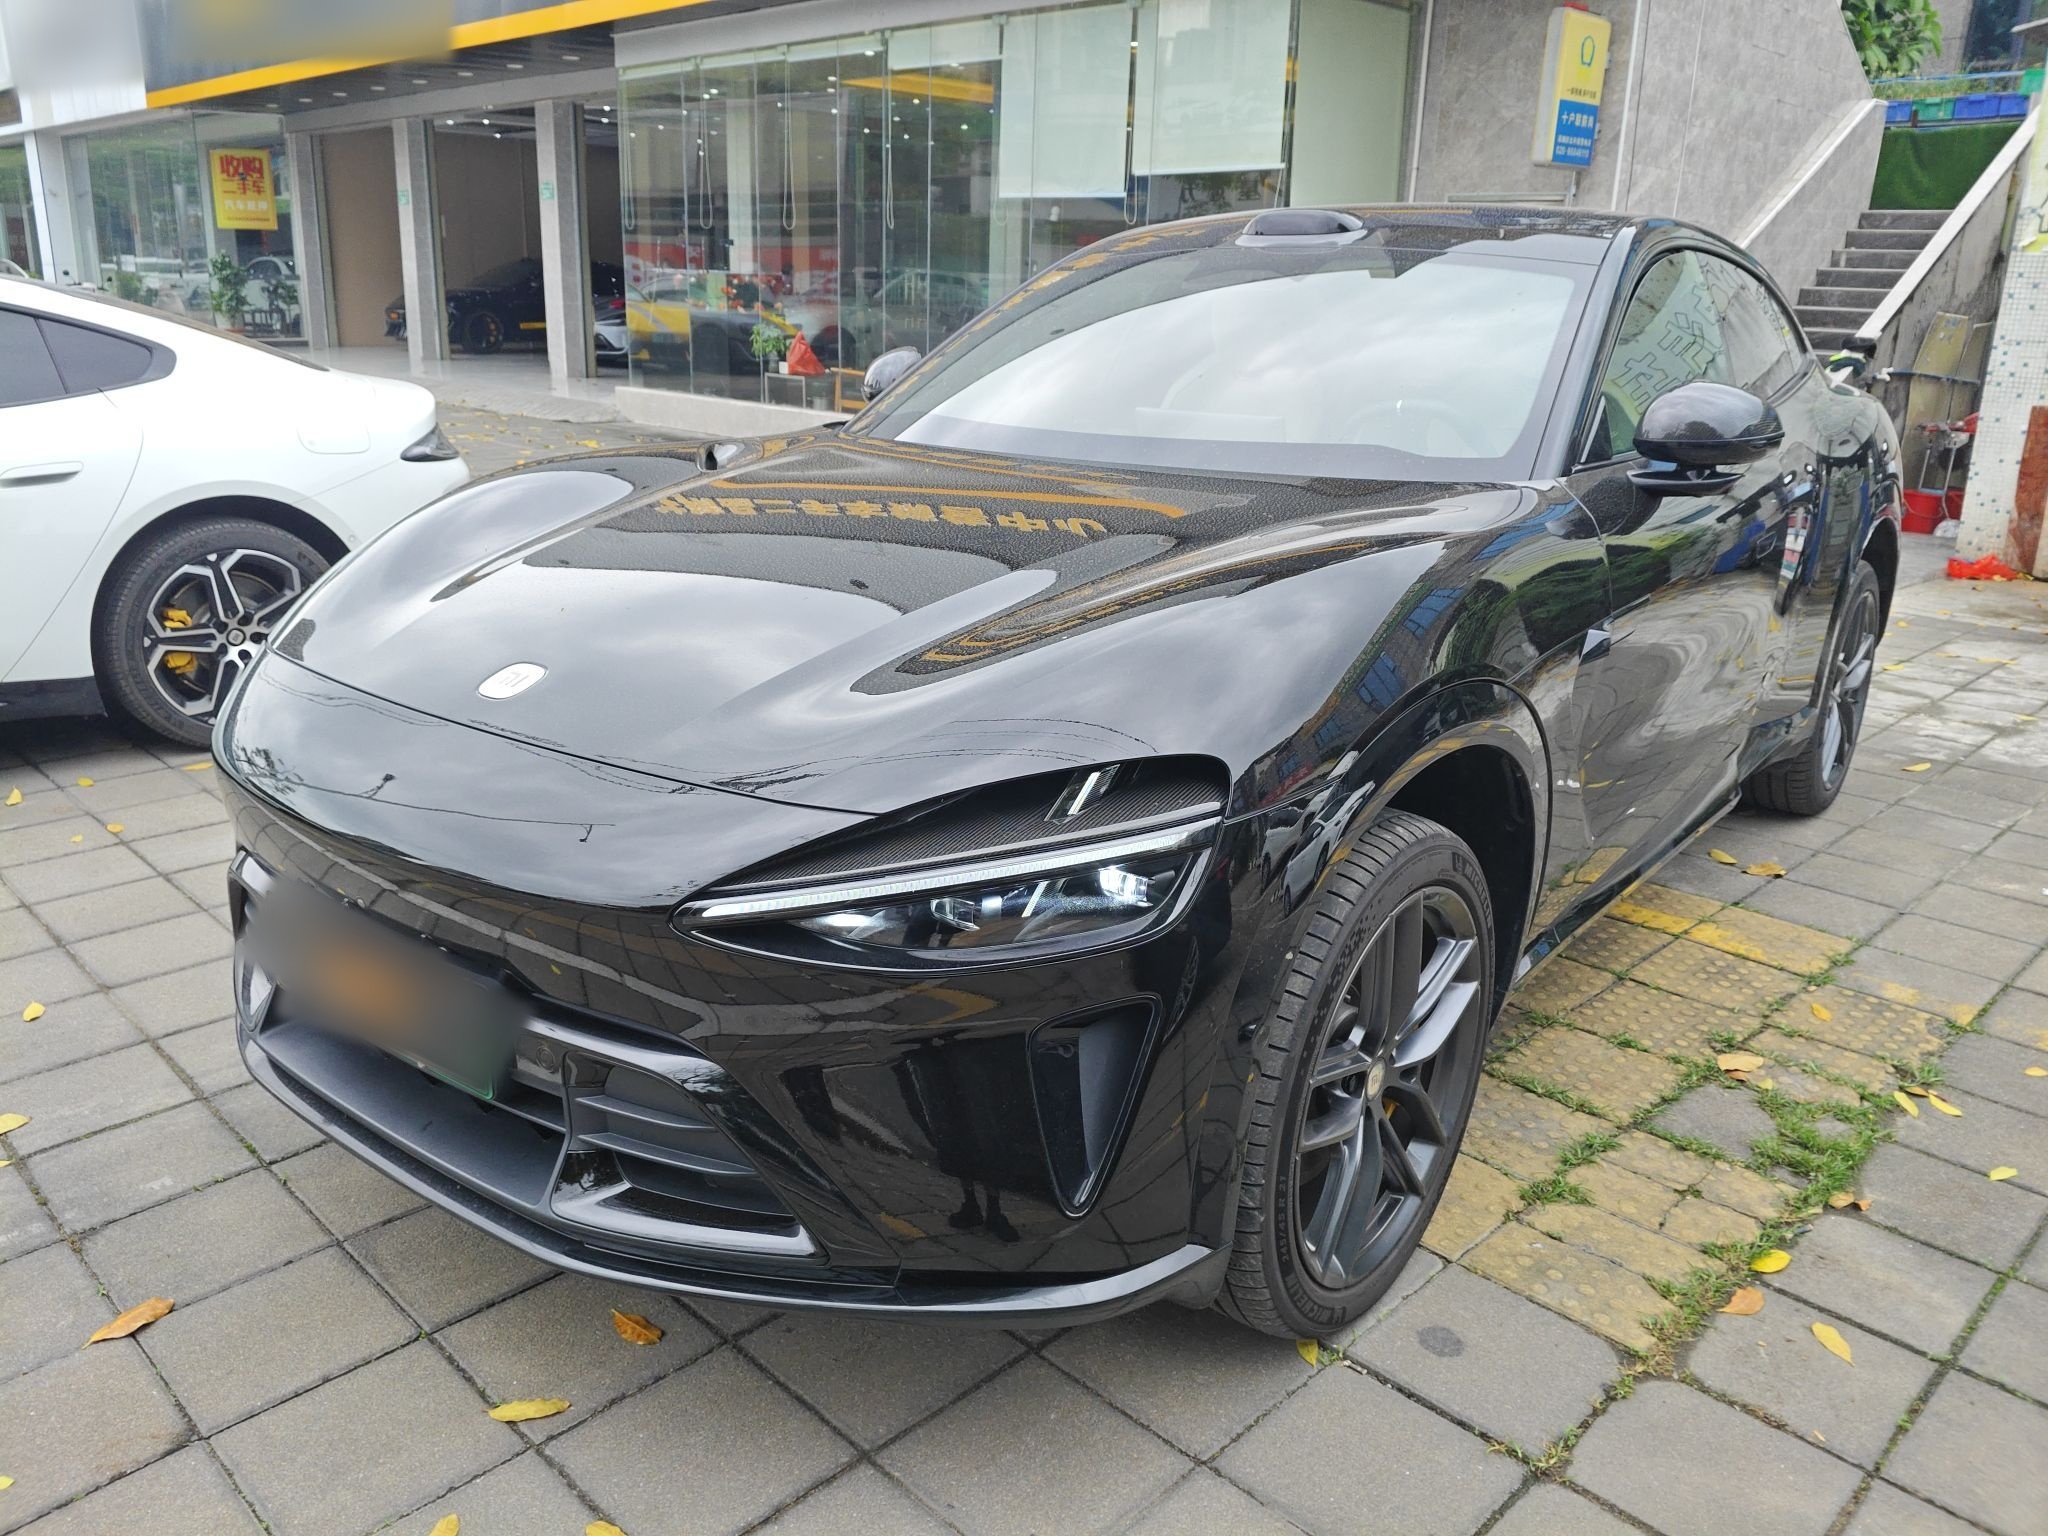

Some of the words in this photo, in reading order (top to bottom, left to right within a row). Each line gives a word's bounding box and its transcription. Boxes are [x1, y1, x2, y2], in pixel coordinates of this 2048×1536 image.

[219, 154, 264, 178] 收购
[222, 178, 266, 196] 二手车
[1464, 862, 1492, 930] MICHELIN
[1285, 1274, 1333, 1323] MICHELIN
